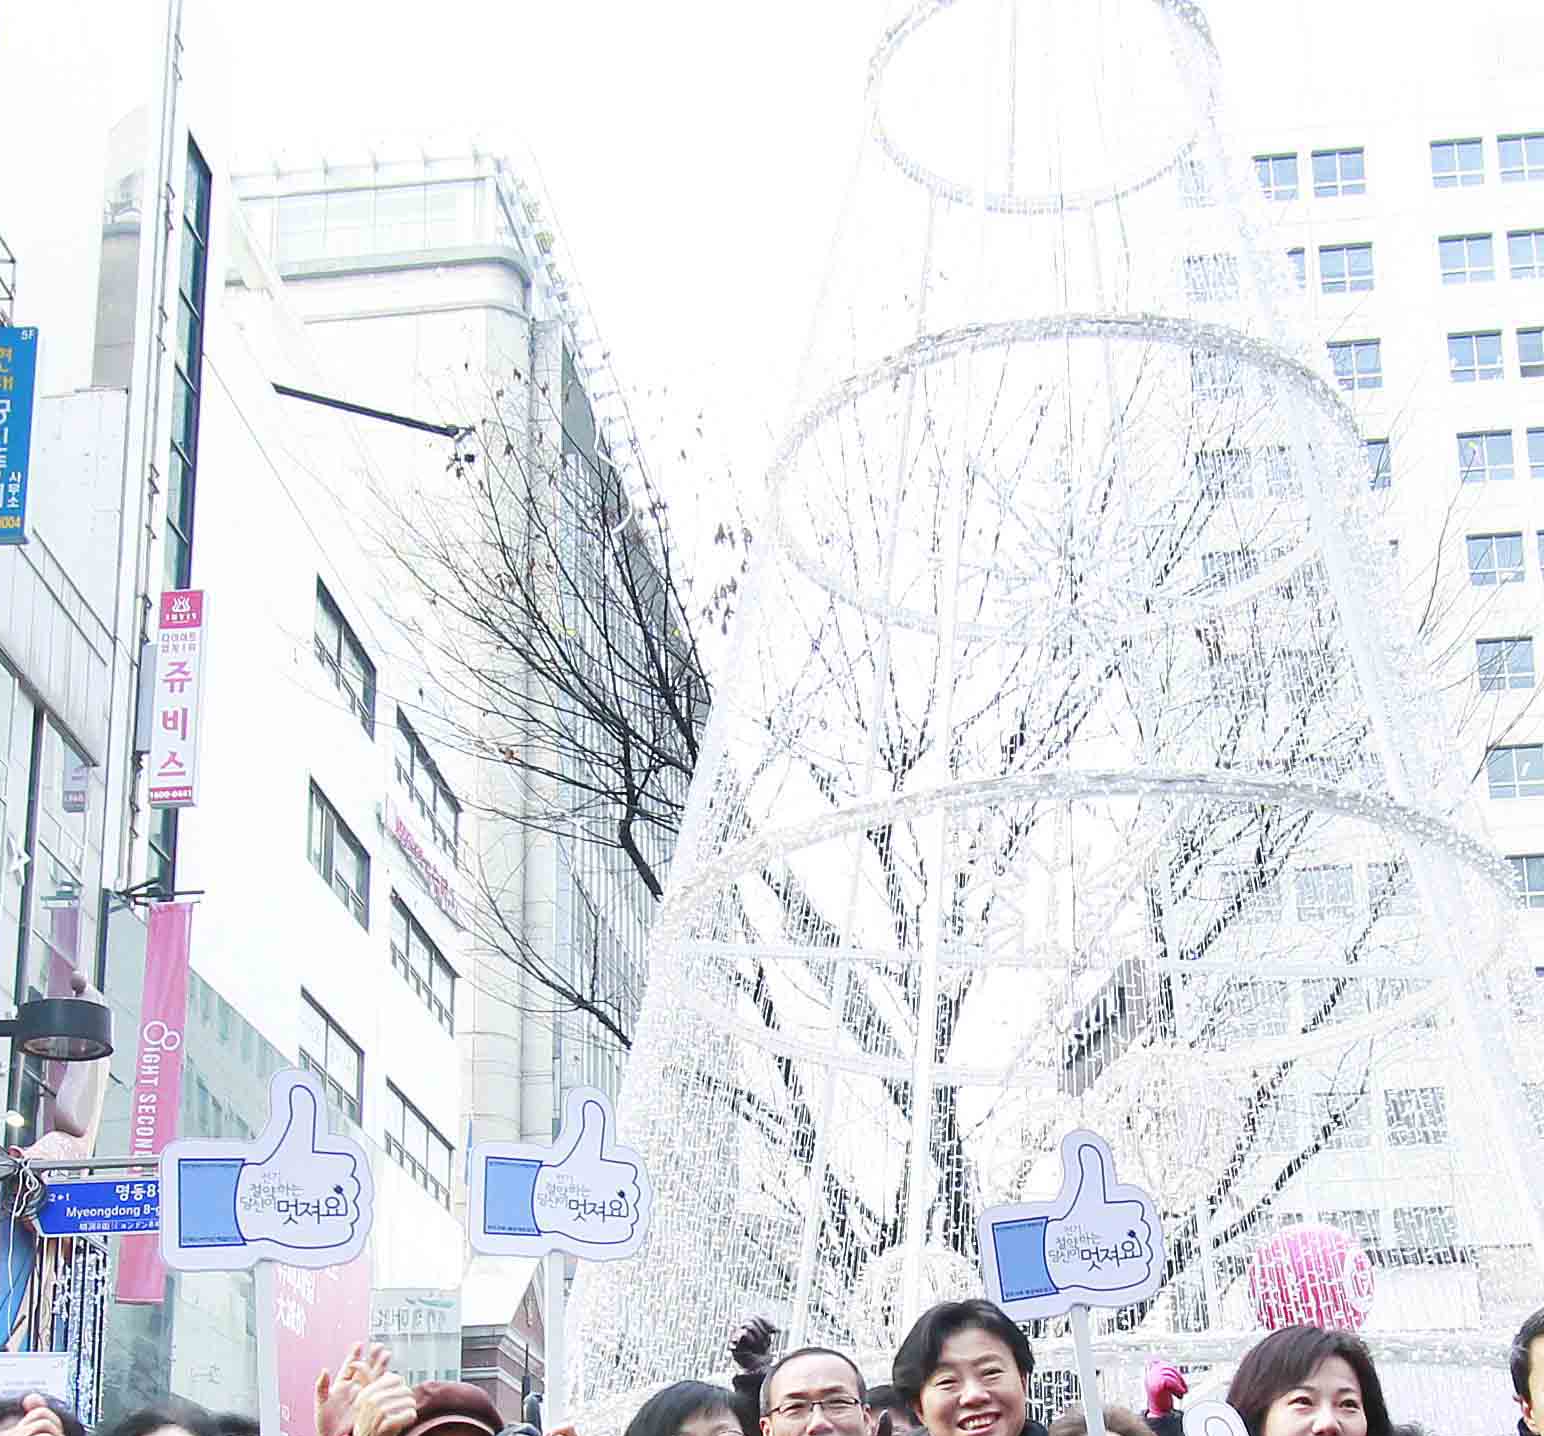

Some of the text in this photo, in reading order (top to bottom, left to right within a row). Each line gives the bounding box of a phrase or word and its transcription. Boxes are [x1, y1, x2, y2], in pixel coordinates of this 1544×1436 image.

[8, 471, 22, 508] 사무소
[157, 661, 192, 776] 쥬비스
[115, 1184, 160, 1201] 명동8
[66, 1204, 140, 1219] Myeongdong
[277, 1196, 347, 1224] 멋져요
[568, 1199, 629, 1223] 멋져요
[1080, 1240, 1143, 1272] 멋져요
